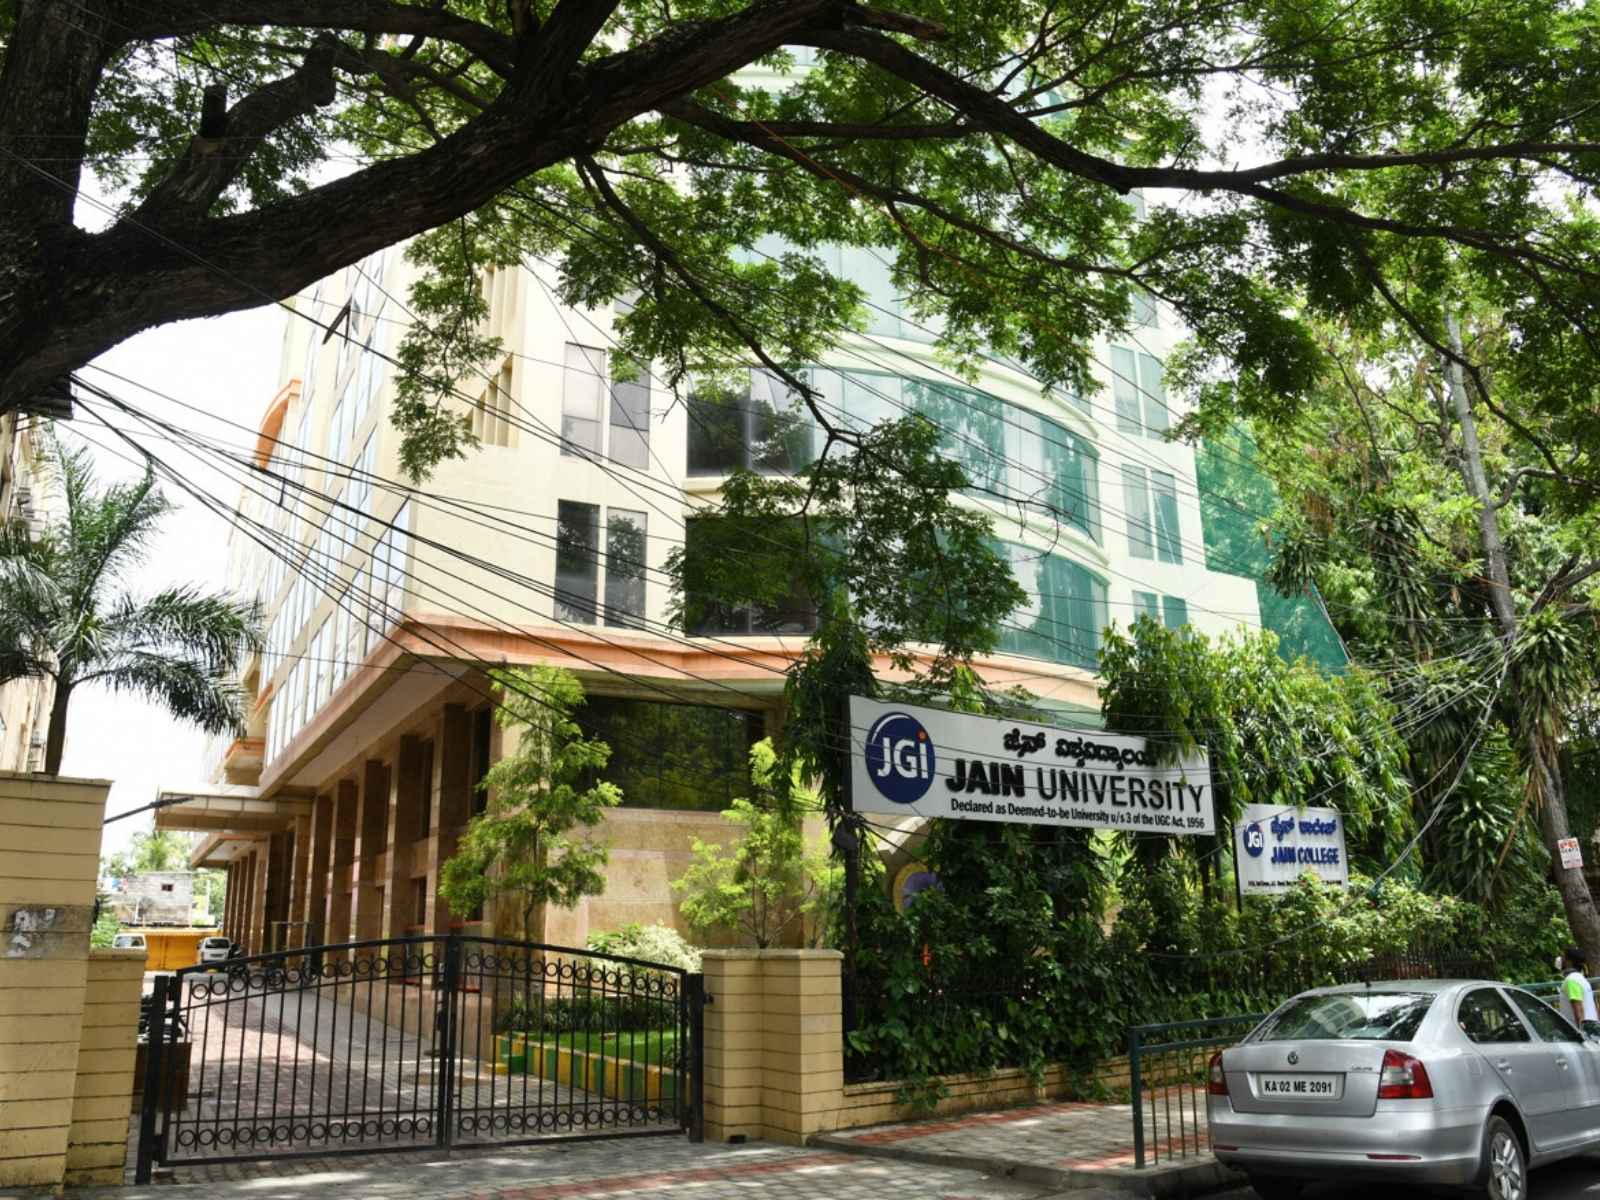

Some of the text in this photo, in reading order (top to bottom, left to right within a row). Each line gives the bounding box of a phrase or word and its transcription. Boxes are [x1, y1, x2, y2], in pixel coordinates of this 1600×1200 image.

[945, 758, 1204, 813] JAIN UNIVERSITY
[951, 798, 994, 814] Declared
[995, 804, 1007, 815] as
[1008, 803, 1070, 819] Deemed-to-be
[1071, 808, 1109, 825] University
[1126, 812, 1132, 824] 3
[1133, 813, 1142, 825] of
[1142, 813, 1154, 825] the
[1154, 814, 1171, 826] UGC
[1172, 816, 1185, 828] Act,
[1187, 817, 1206, 829] 1956
[1271, 847, 1340, 864] JAIN COLLEGE
[1264, 1080, 1332, 1093] KA 02 ME 2091
